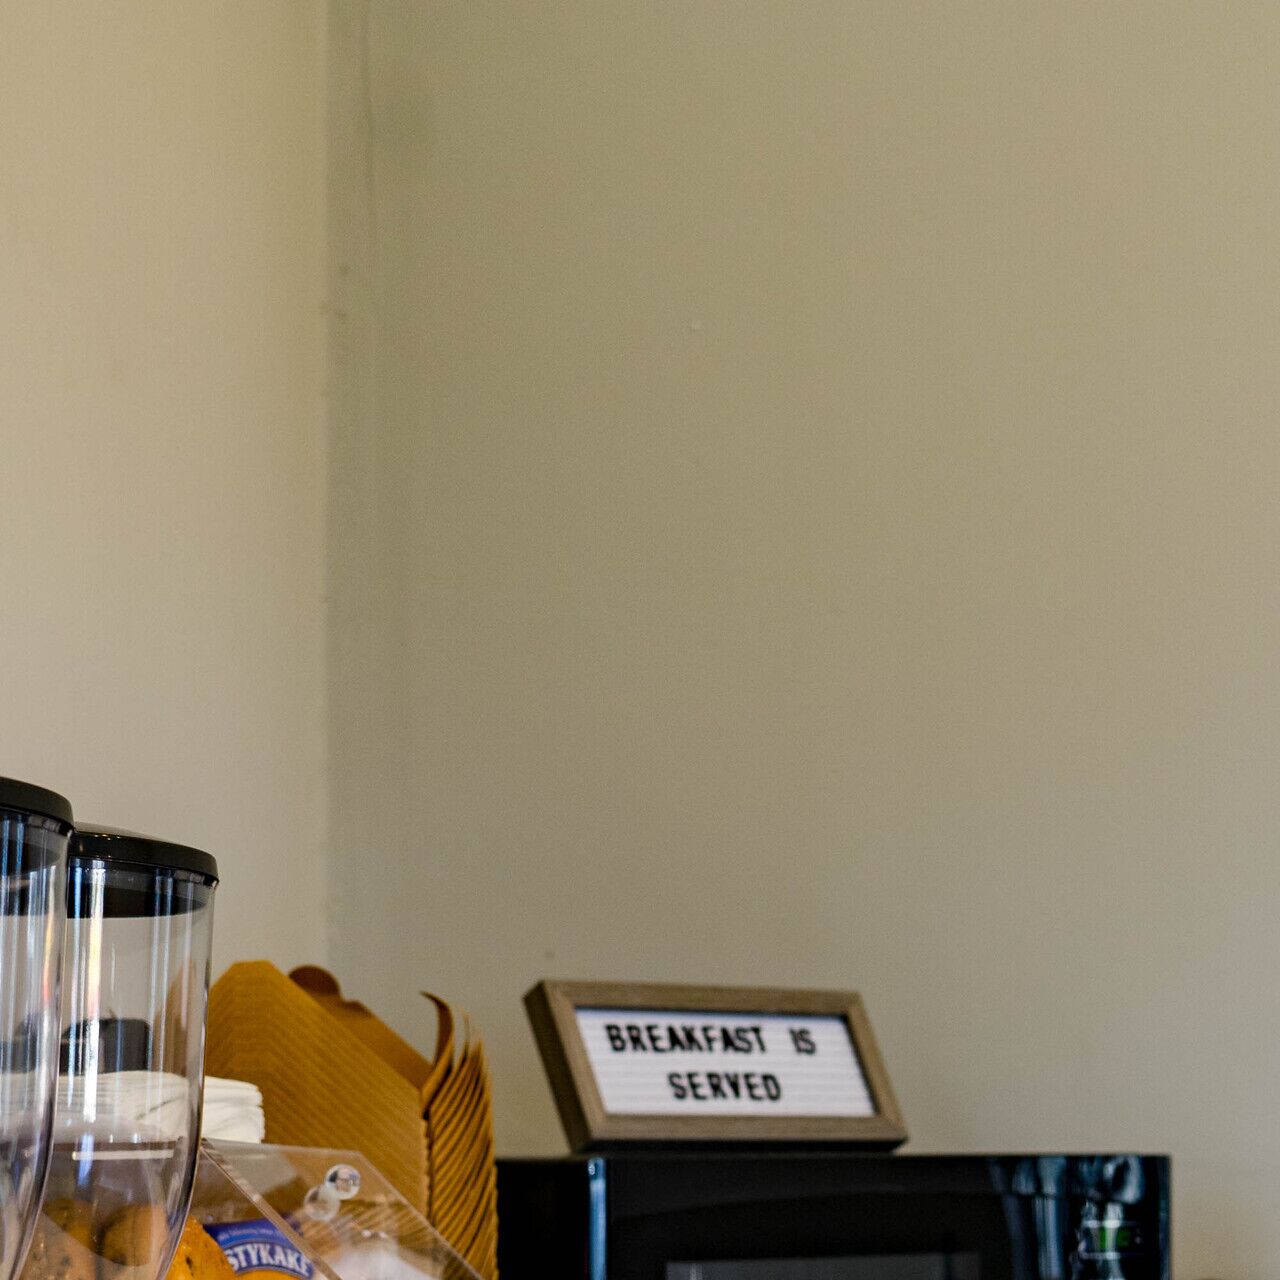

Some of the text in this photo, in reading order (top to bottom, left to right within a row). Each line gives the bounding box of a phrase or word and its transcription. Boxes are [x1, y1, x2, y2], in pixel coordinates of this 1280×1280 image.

[605, 1023, 817, 1056] BREAKFAST IS
[668, 1072, 782, 1101] SERVED
[224, 1243, 312, 1277] STYKAKE
